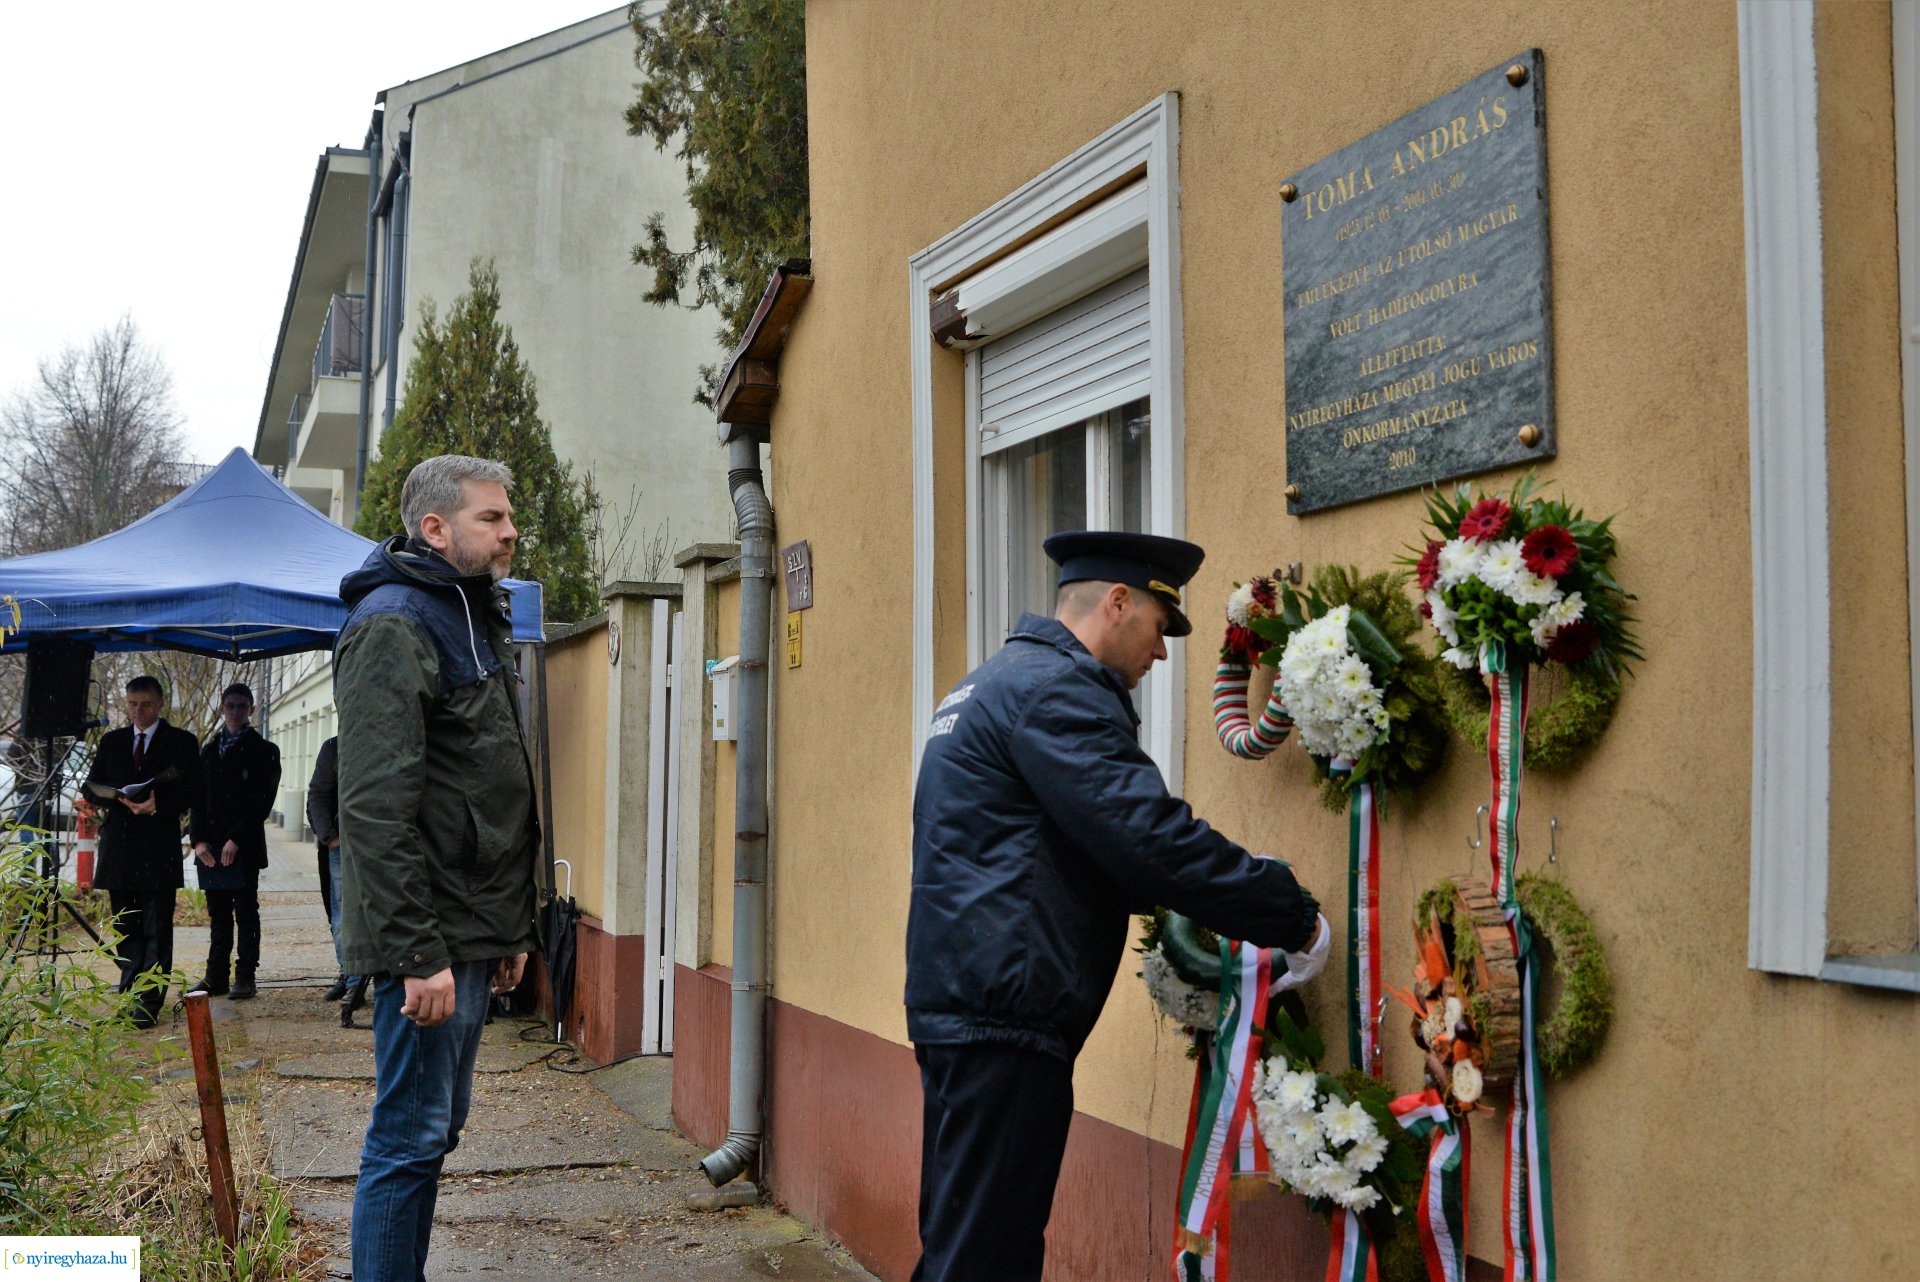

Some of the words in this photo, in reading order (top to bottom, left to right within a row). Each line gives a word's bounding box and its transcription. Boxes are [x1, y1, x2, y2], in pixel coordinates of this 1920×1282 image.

[1302, 165, 1374, 221] TOMA
[1390, 95, 1508, 180] ANDRÁS
[1376, 255, 1393, 278] AZ
[1457, 202, 1519, 244] MAGYAR
[1329, 313, 1362, 340] VOLT
[1368, 270, 1478, 326] HADIFOGOLYRA
[1382, 370, 1437, 404] MEGYEI
[1388, 447, 1417, 471] 2010
